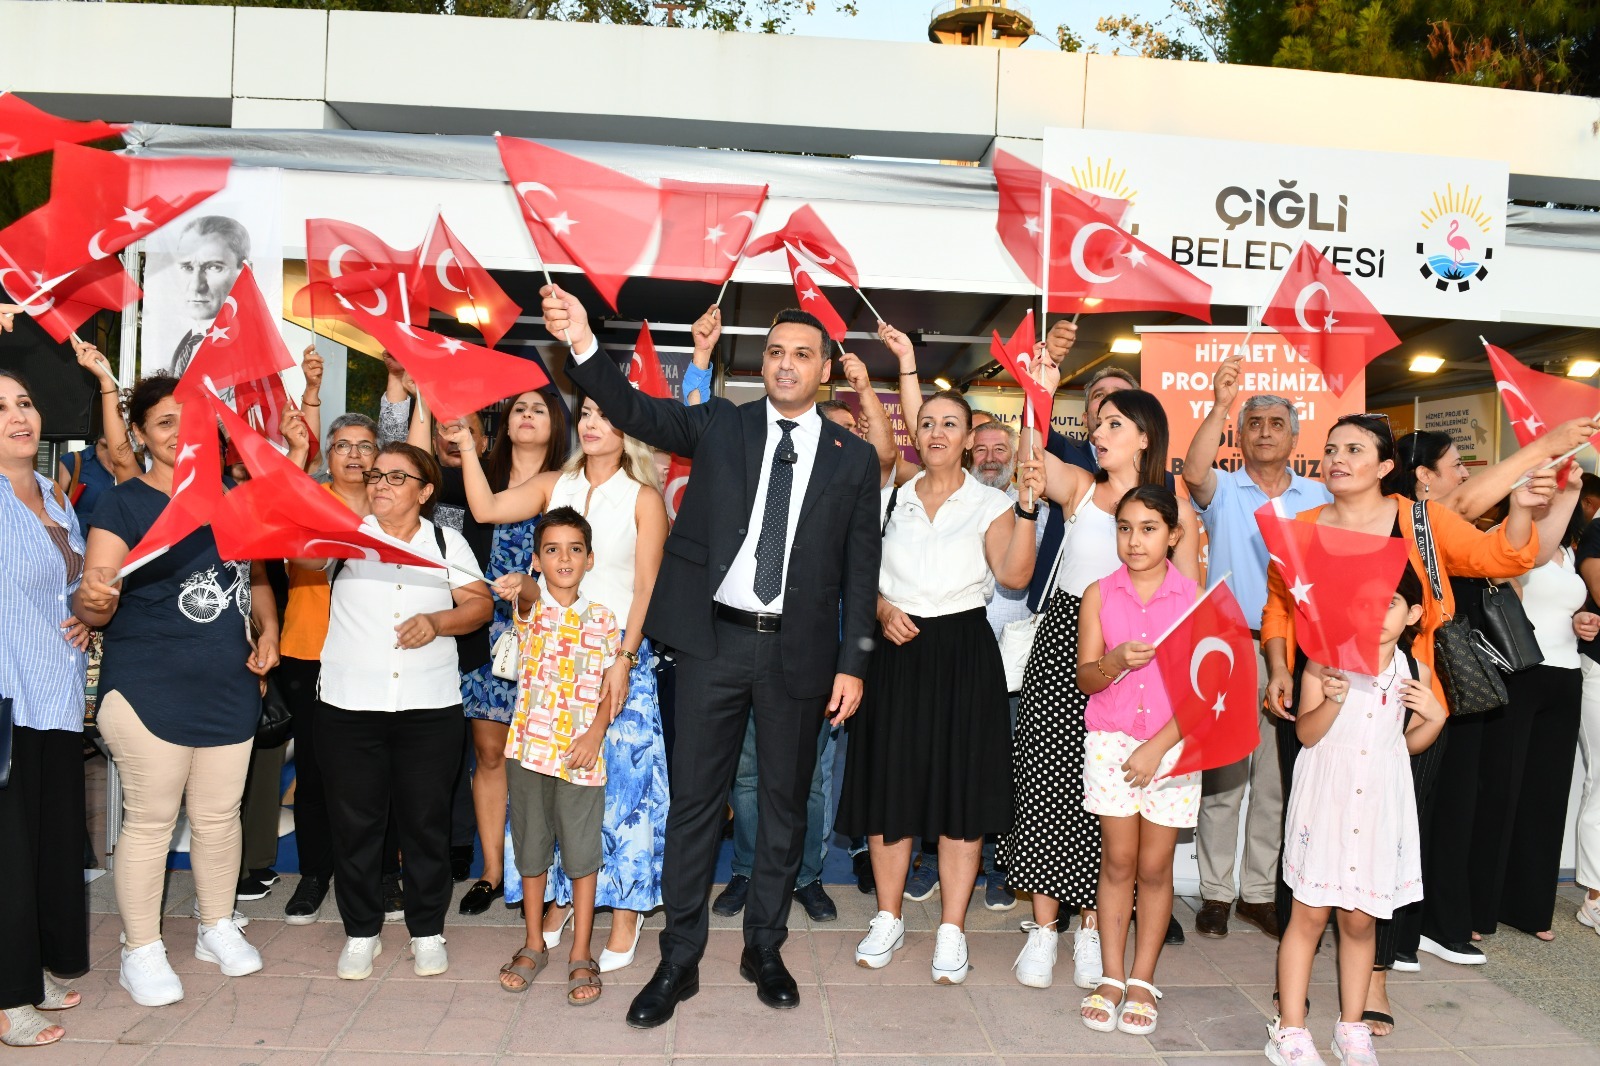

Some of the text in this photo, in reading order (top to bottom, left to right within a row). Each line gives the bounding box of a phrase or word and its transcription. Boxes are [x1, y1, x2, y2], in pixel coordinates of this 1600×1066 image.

[1215, 179, 1348, 232] ÇİĞLİ
[1195, 338, 1311, 363] HİZMET VE
[1161, 367, 1344, 392] PROJERİMİZİN
